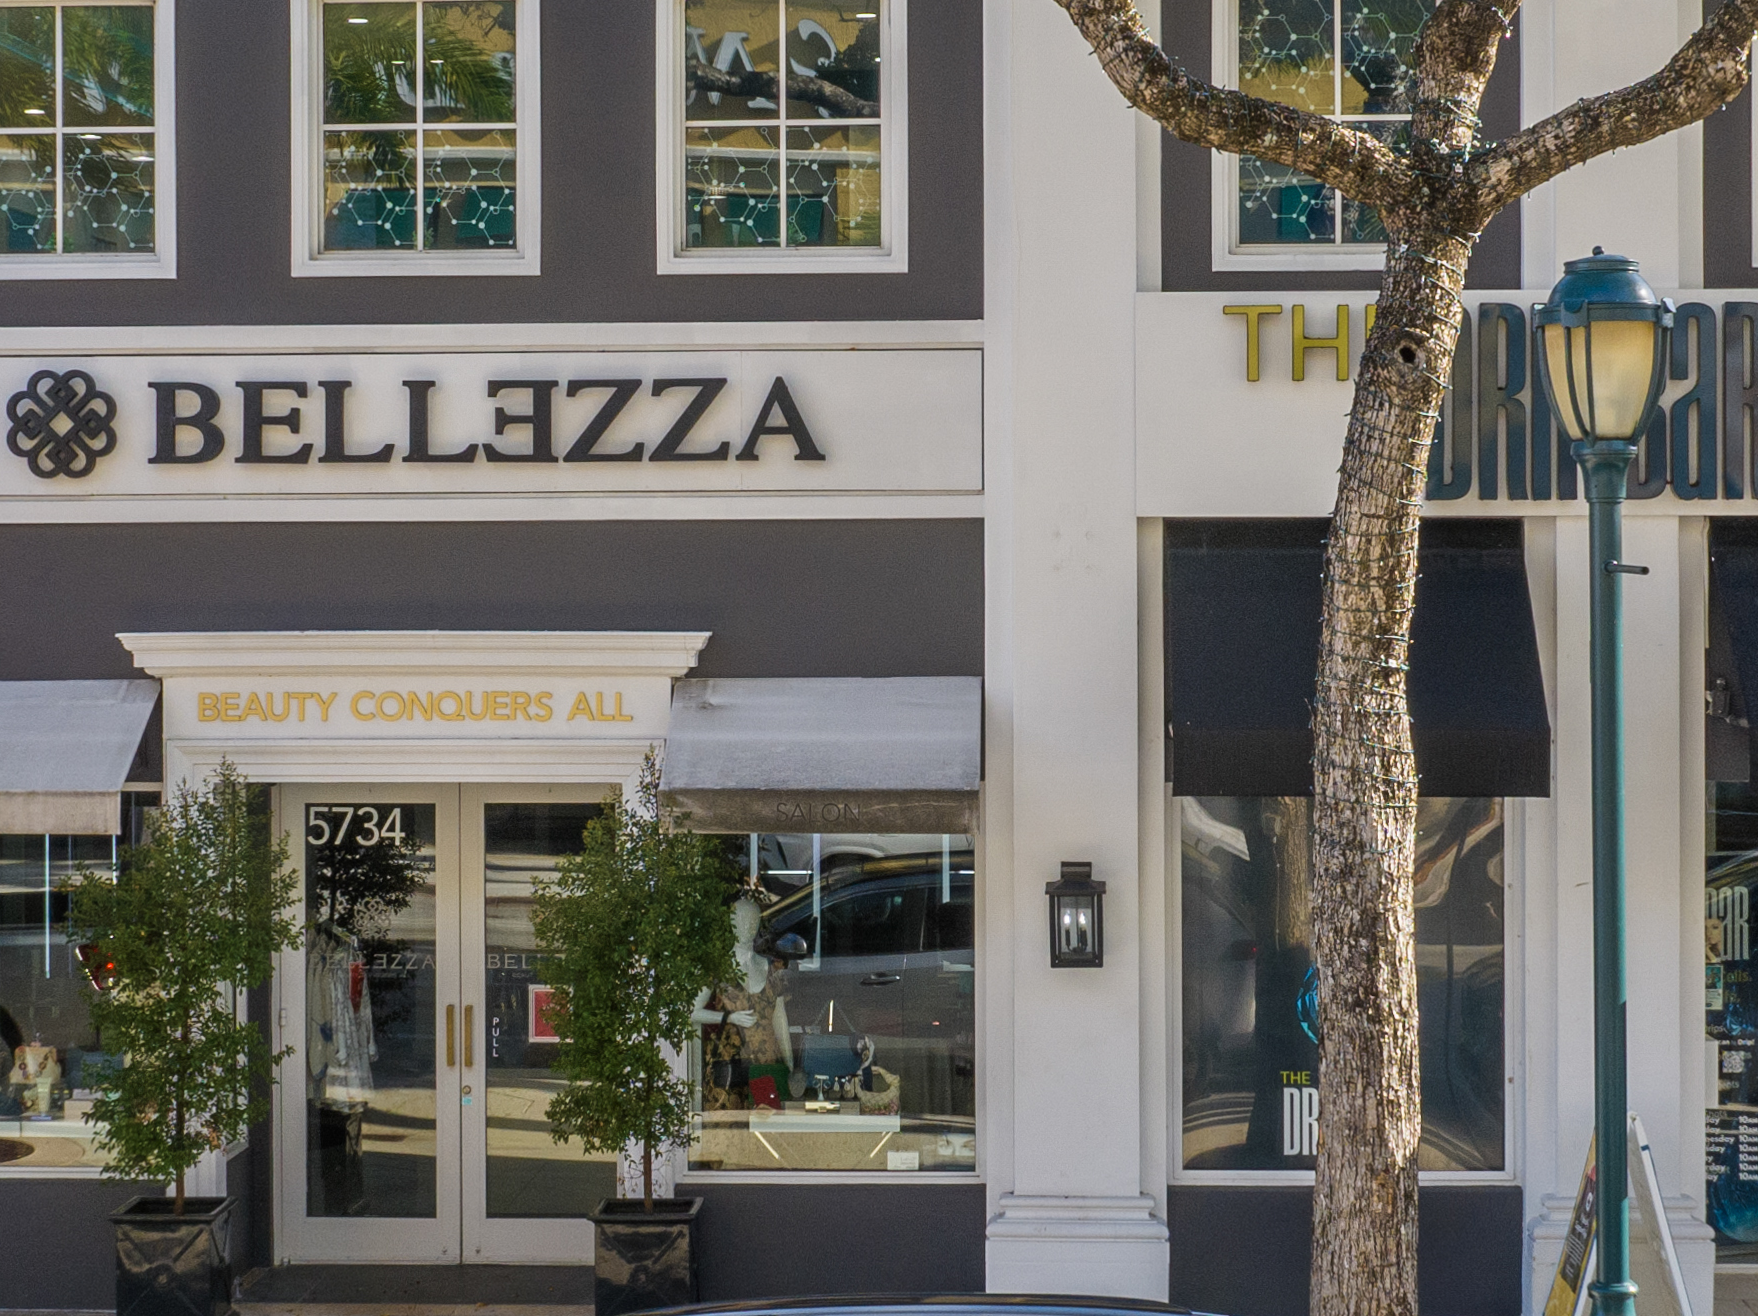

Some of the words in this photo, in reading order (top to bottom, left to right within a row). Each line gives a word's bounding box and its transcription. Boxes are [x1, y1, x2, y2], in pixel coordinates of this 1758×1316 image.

[1222, 304, 1377, 382] TH
[196, 690, 337, 723] BEAUTY
[350, 690, 553, 723] CONQUERS
[566, 690, 634, 722] ALL
[307, 806, 406, 846] 5734
[776, 802, 862, 823] SALON
[492, 1016, 500, 1058] PULL
[1280, 1071, 1311, 1084] THE
